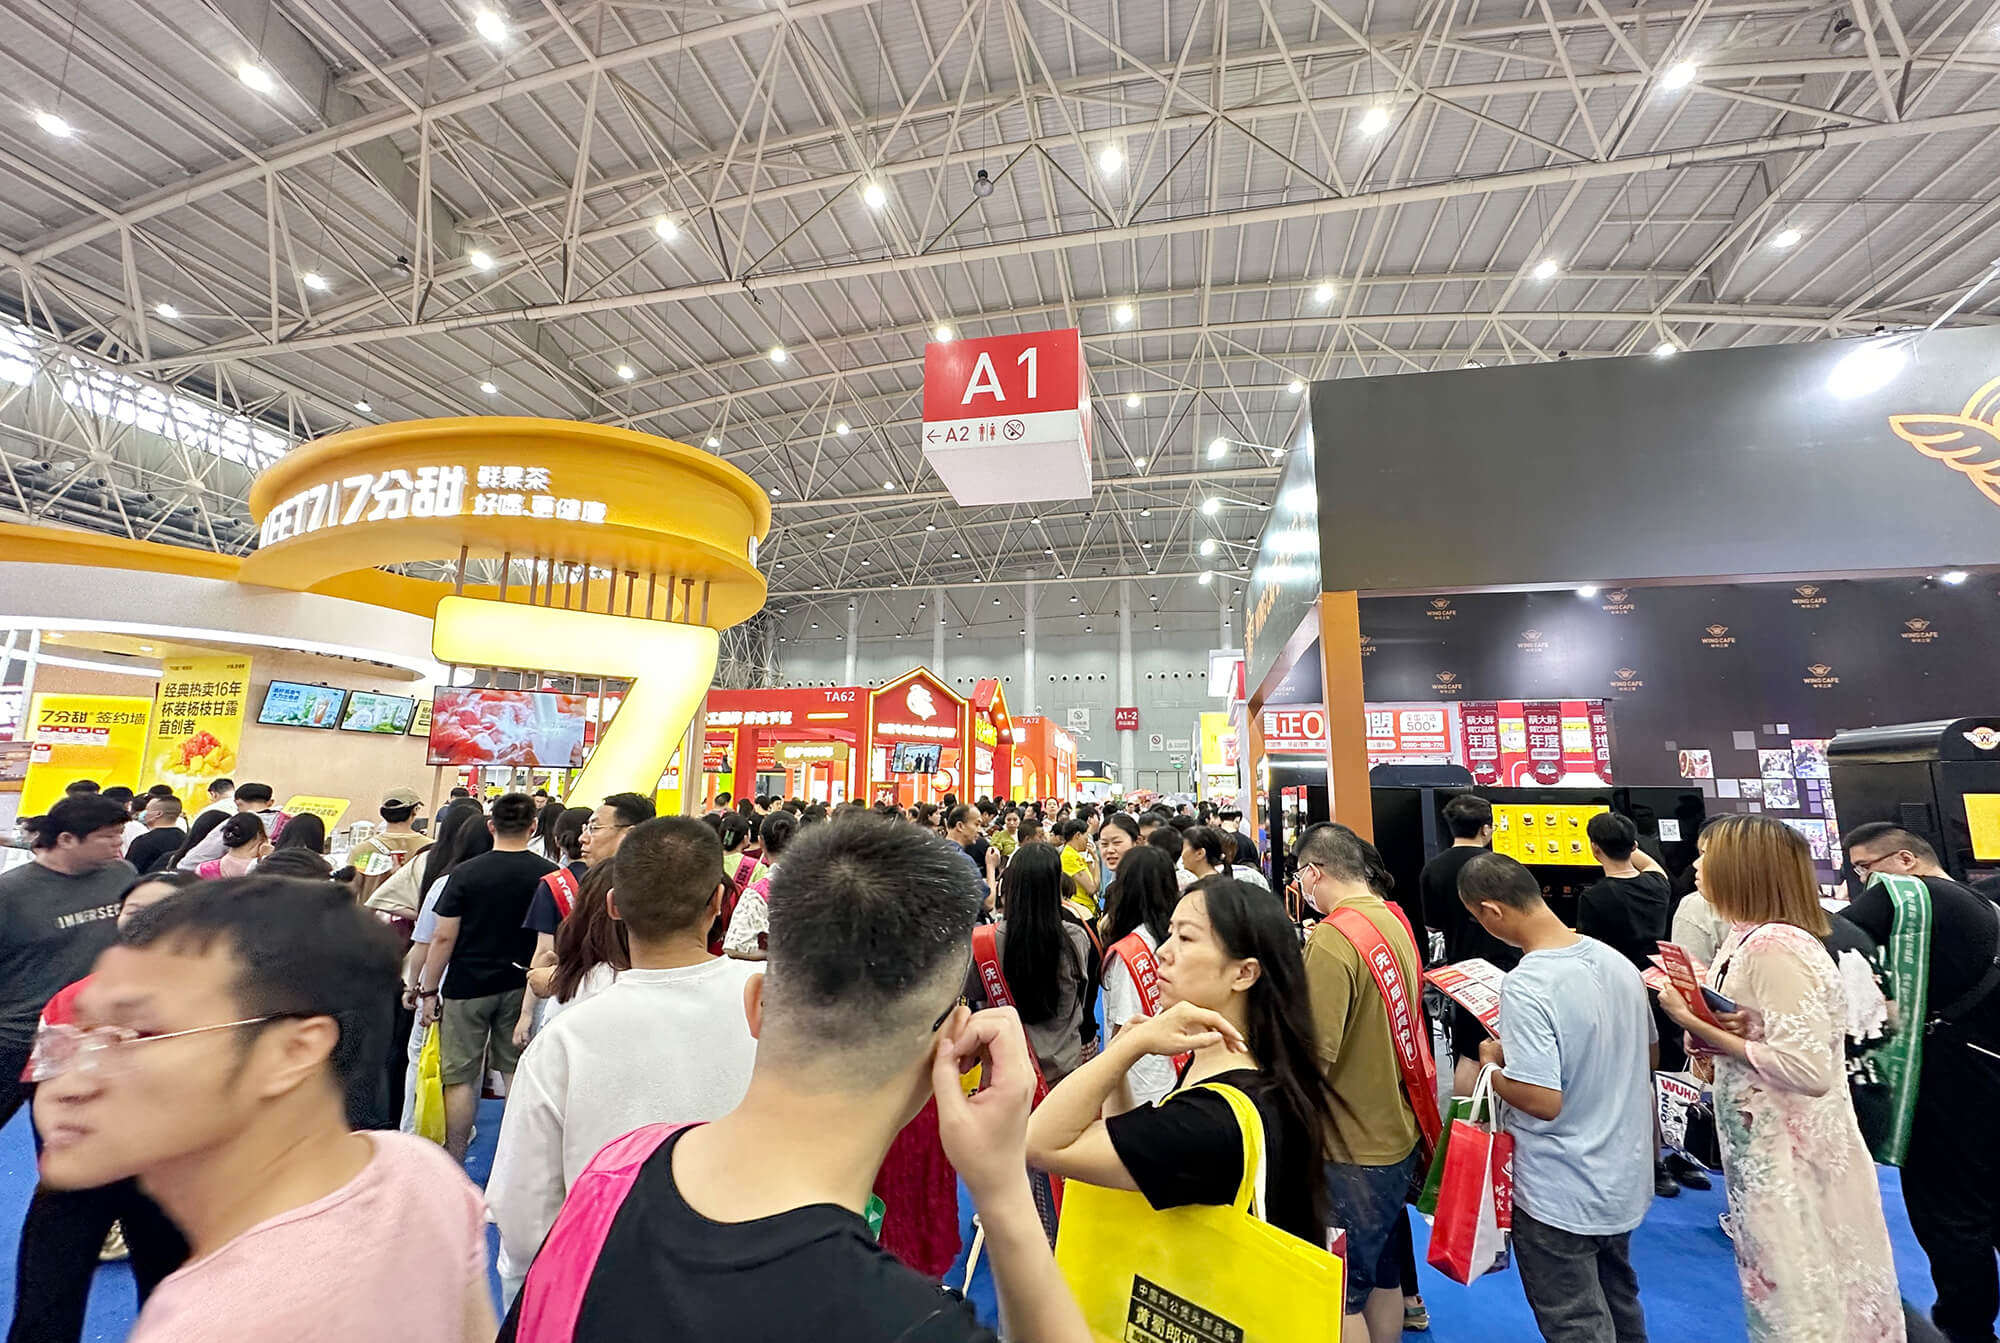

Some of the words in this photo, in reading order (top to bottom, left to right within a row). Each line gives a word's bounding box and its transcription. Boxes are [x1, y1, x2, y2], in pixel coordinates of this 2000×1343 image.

[960, 346, 1038, 405] A1
[945, 426, 969, 442] A2
[341, 465, 465, 526] 7分甜
[164, 681, 242, 698] 经典热卖16年
[824, 690, 856, 703] TA62
[161, 700, 239, 717] 杯装杨枝甘露
[1116, 711, 1138, 721] A1-2
[95, 711, 147, 726] 签约墙
[1022, 717, 1040, 725] TA72
[1365, 711, 1395, 738] 盟
[1406, 721, 1436, 731] 500+
[158, 719, 196, 735] 首创者
[1468, 734, 1497, 748] 年度
[1530, 734, 1560, 748] 年度
